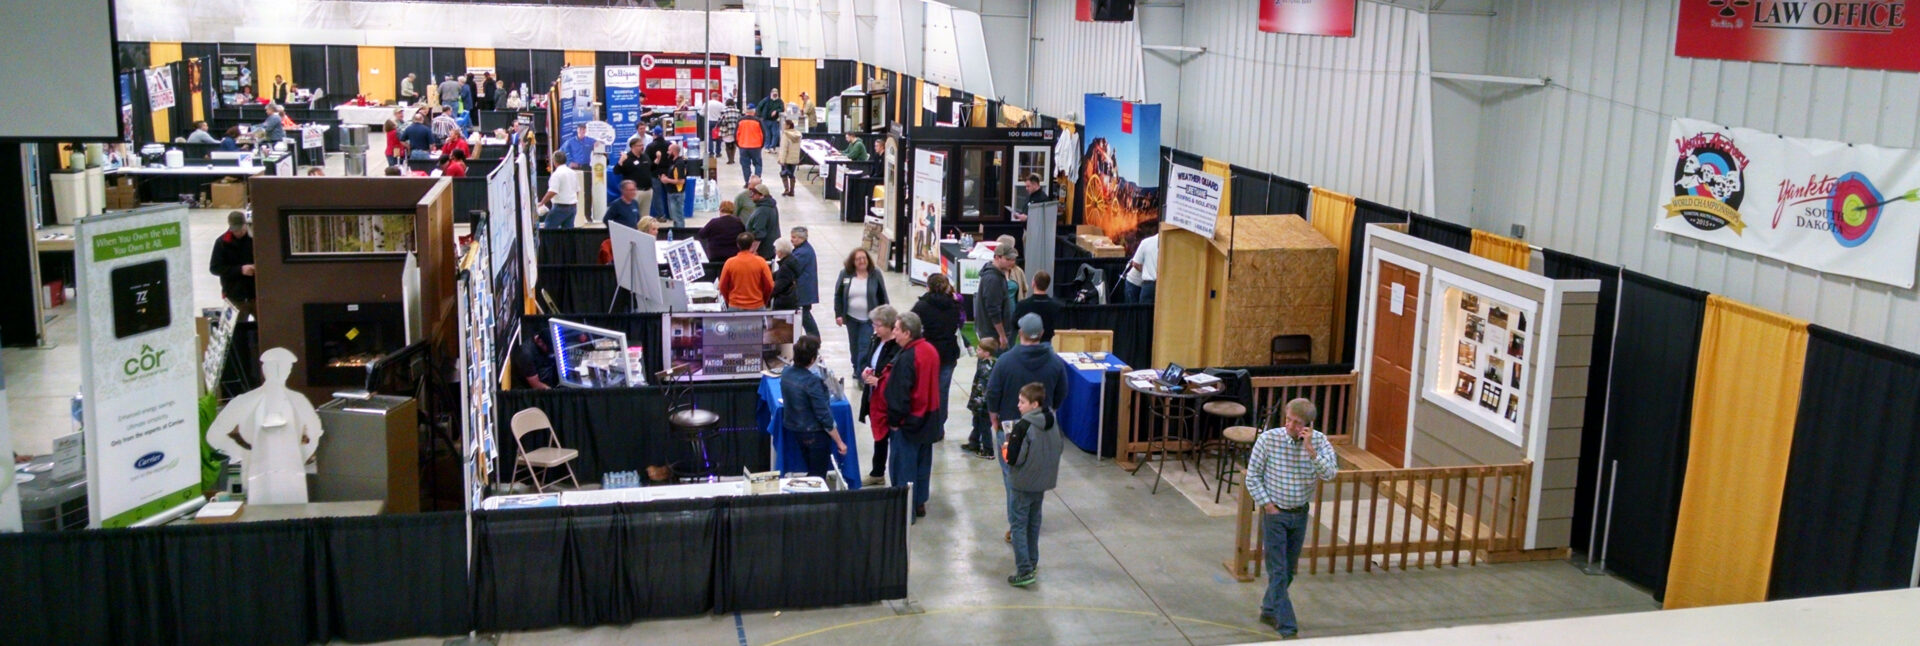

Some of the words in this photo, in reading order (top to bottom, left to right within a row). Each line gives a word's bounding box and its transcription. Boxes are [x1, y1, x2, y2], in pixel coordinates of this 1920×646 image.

[1753, 2, 1807, 24] LAW
[1812, 2, 1904, 27] OFFICE
[607, 69, 637, 80] Culligan
[1675, 131, 1707, 159] Youth
[1709, 132, 1750, 171] Archery
[1177, 172, 1201, 185] WEATHER
[1201, 177, 1219, 191] GUARD
[1672, 198, 1693, 208] WORLD
[1805, 207, 1844, 221] SOUTH
[1796, 216, 1843, 233] DAKOTA
[96, 237, 117, 248] When
[118, 235, 132, 243] You
[132, 232, 148, 241] Own
[150, 229, 160, 238] the
[114, 246, 127, 255] You
[128, 244, 144, 252] Own
[136, 290, 148, 301] 72
[124, 344, 165, 376] côr
[736, 364, 761, 373] GARAGES
[138, 454, 161, 467] Carrier
